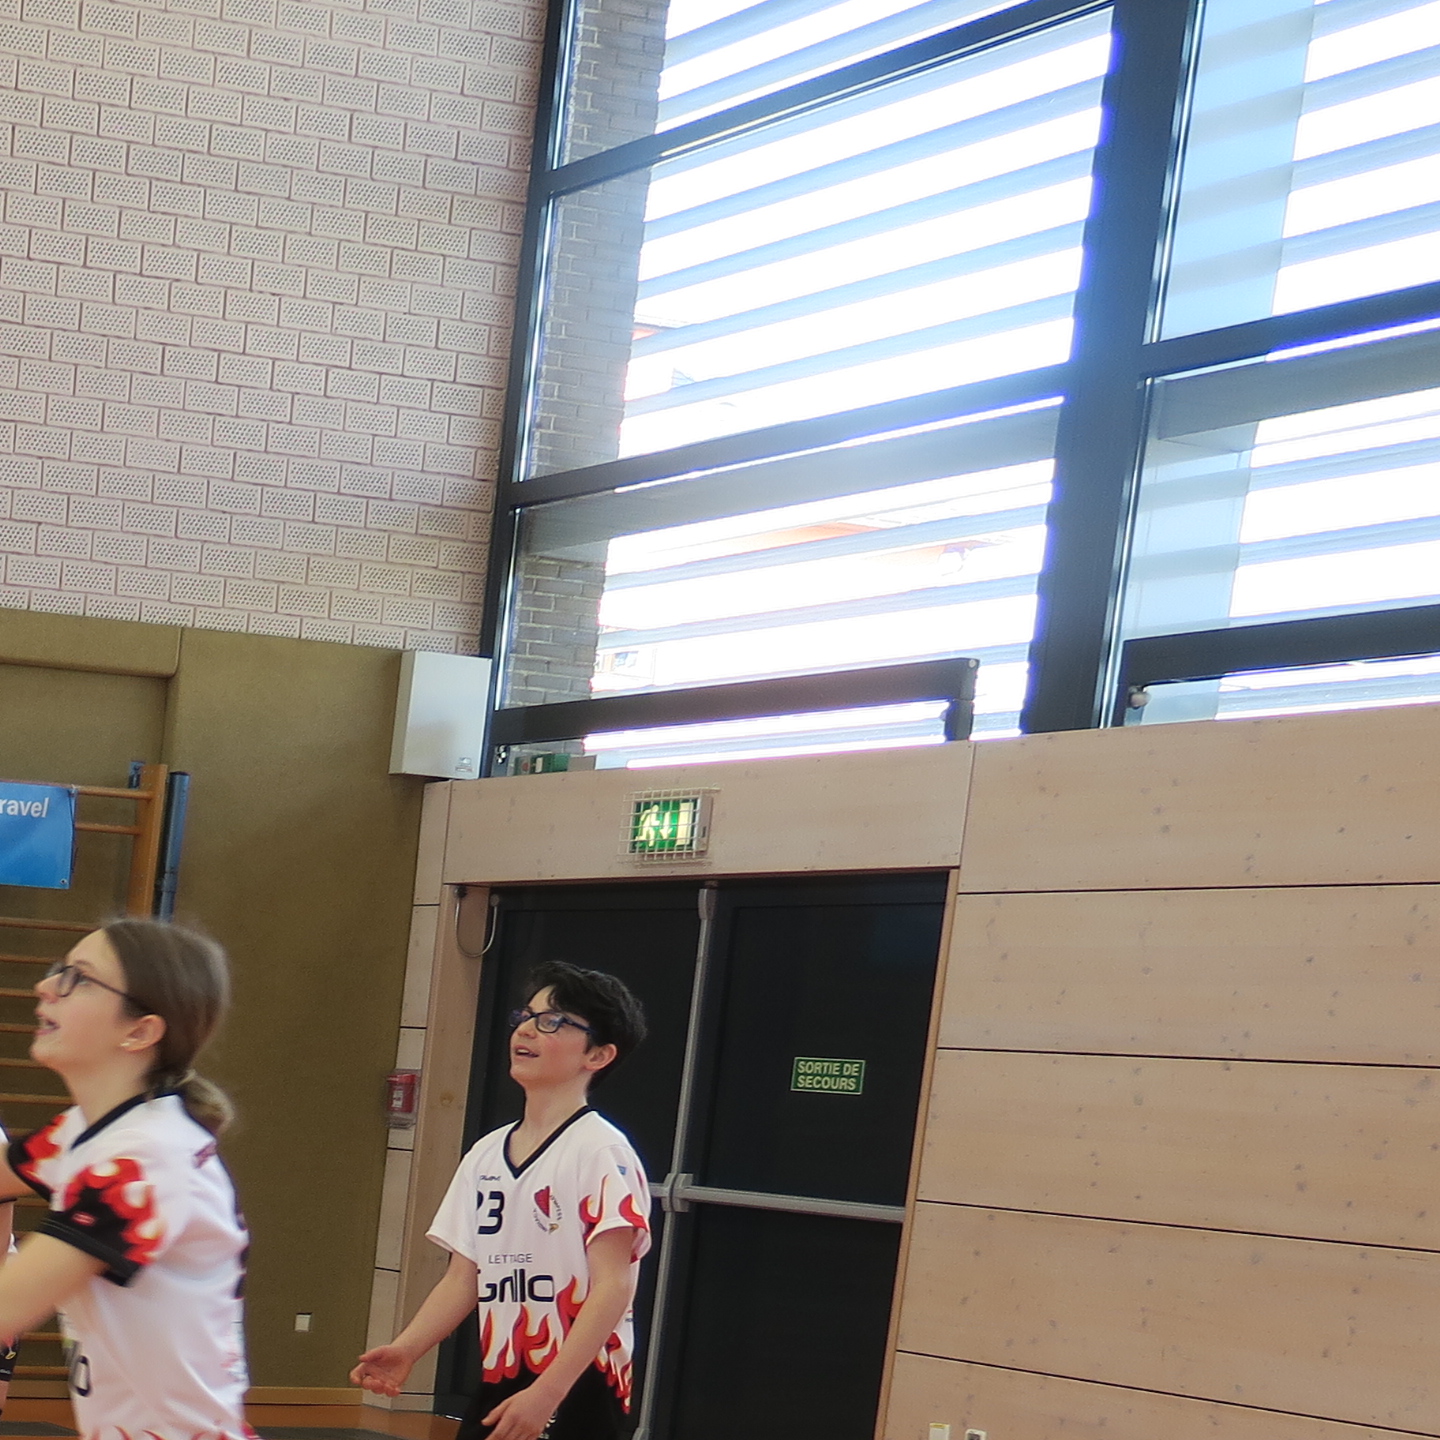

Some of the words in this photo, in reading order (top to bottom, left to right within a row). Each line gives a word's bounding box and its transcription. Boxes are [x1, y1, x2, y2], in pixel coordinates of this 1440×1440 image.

[797, 1061, 840, 1075] SORTIE
[843, 1063, 860, 1076] DE
[796, 1075, 857, 1091] SECOURS
